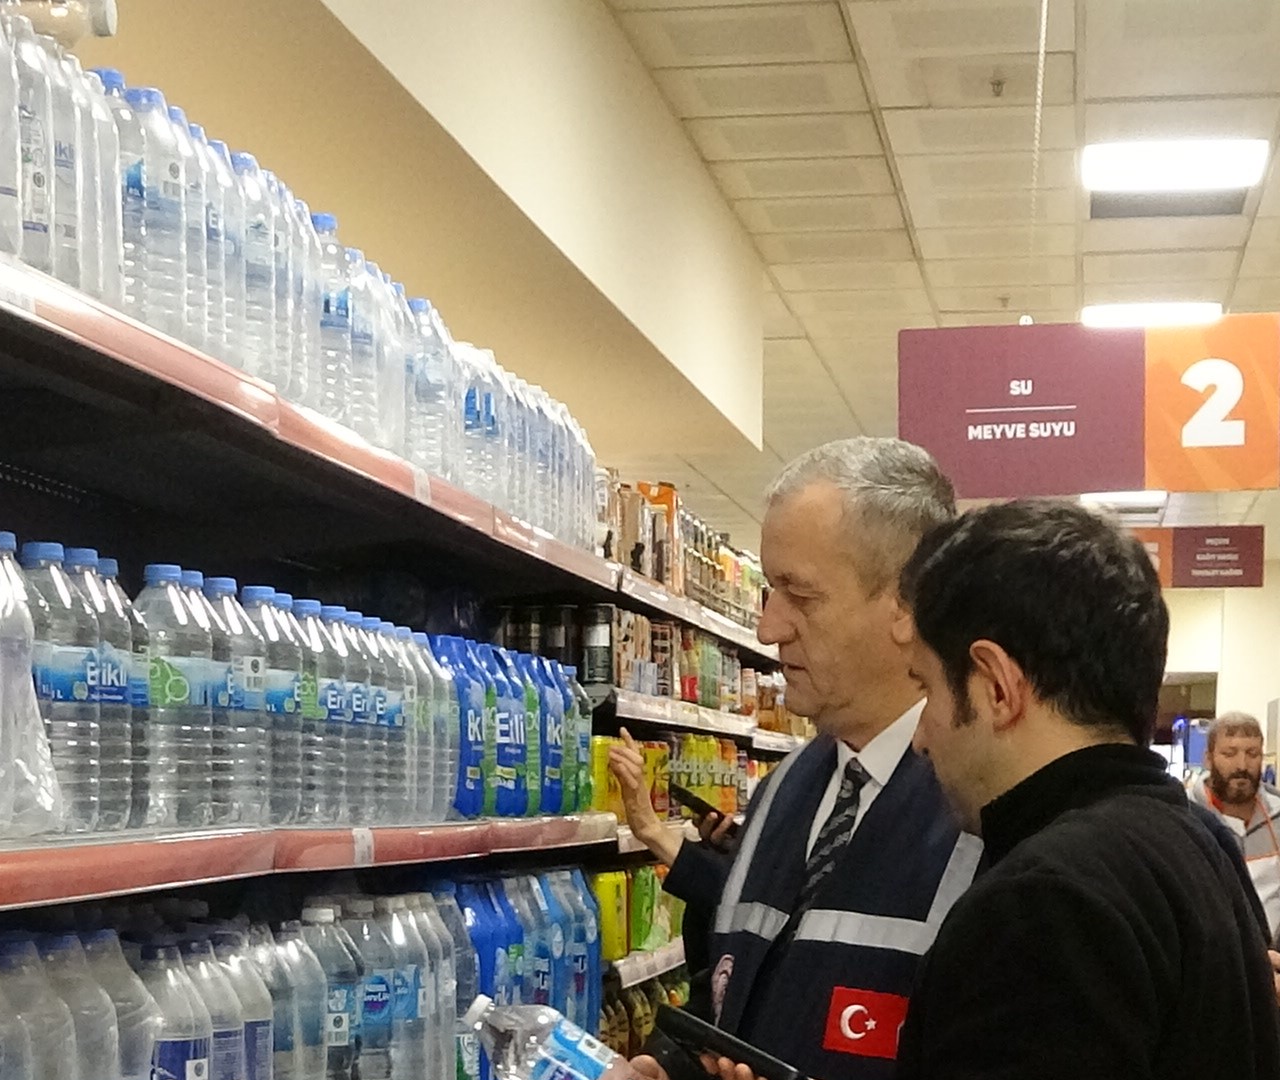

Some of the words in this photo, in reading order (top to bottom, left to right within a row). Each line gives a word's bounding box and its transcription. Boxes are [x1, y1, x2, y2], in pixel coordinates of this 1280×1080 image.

[1009, 379, 1033, 396] SU
[1180, 357, 1246, 448] 2
[967, 423, 1026, 441] MEYVE
[1028, 420, 1076, 438] SUYU
